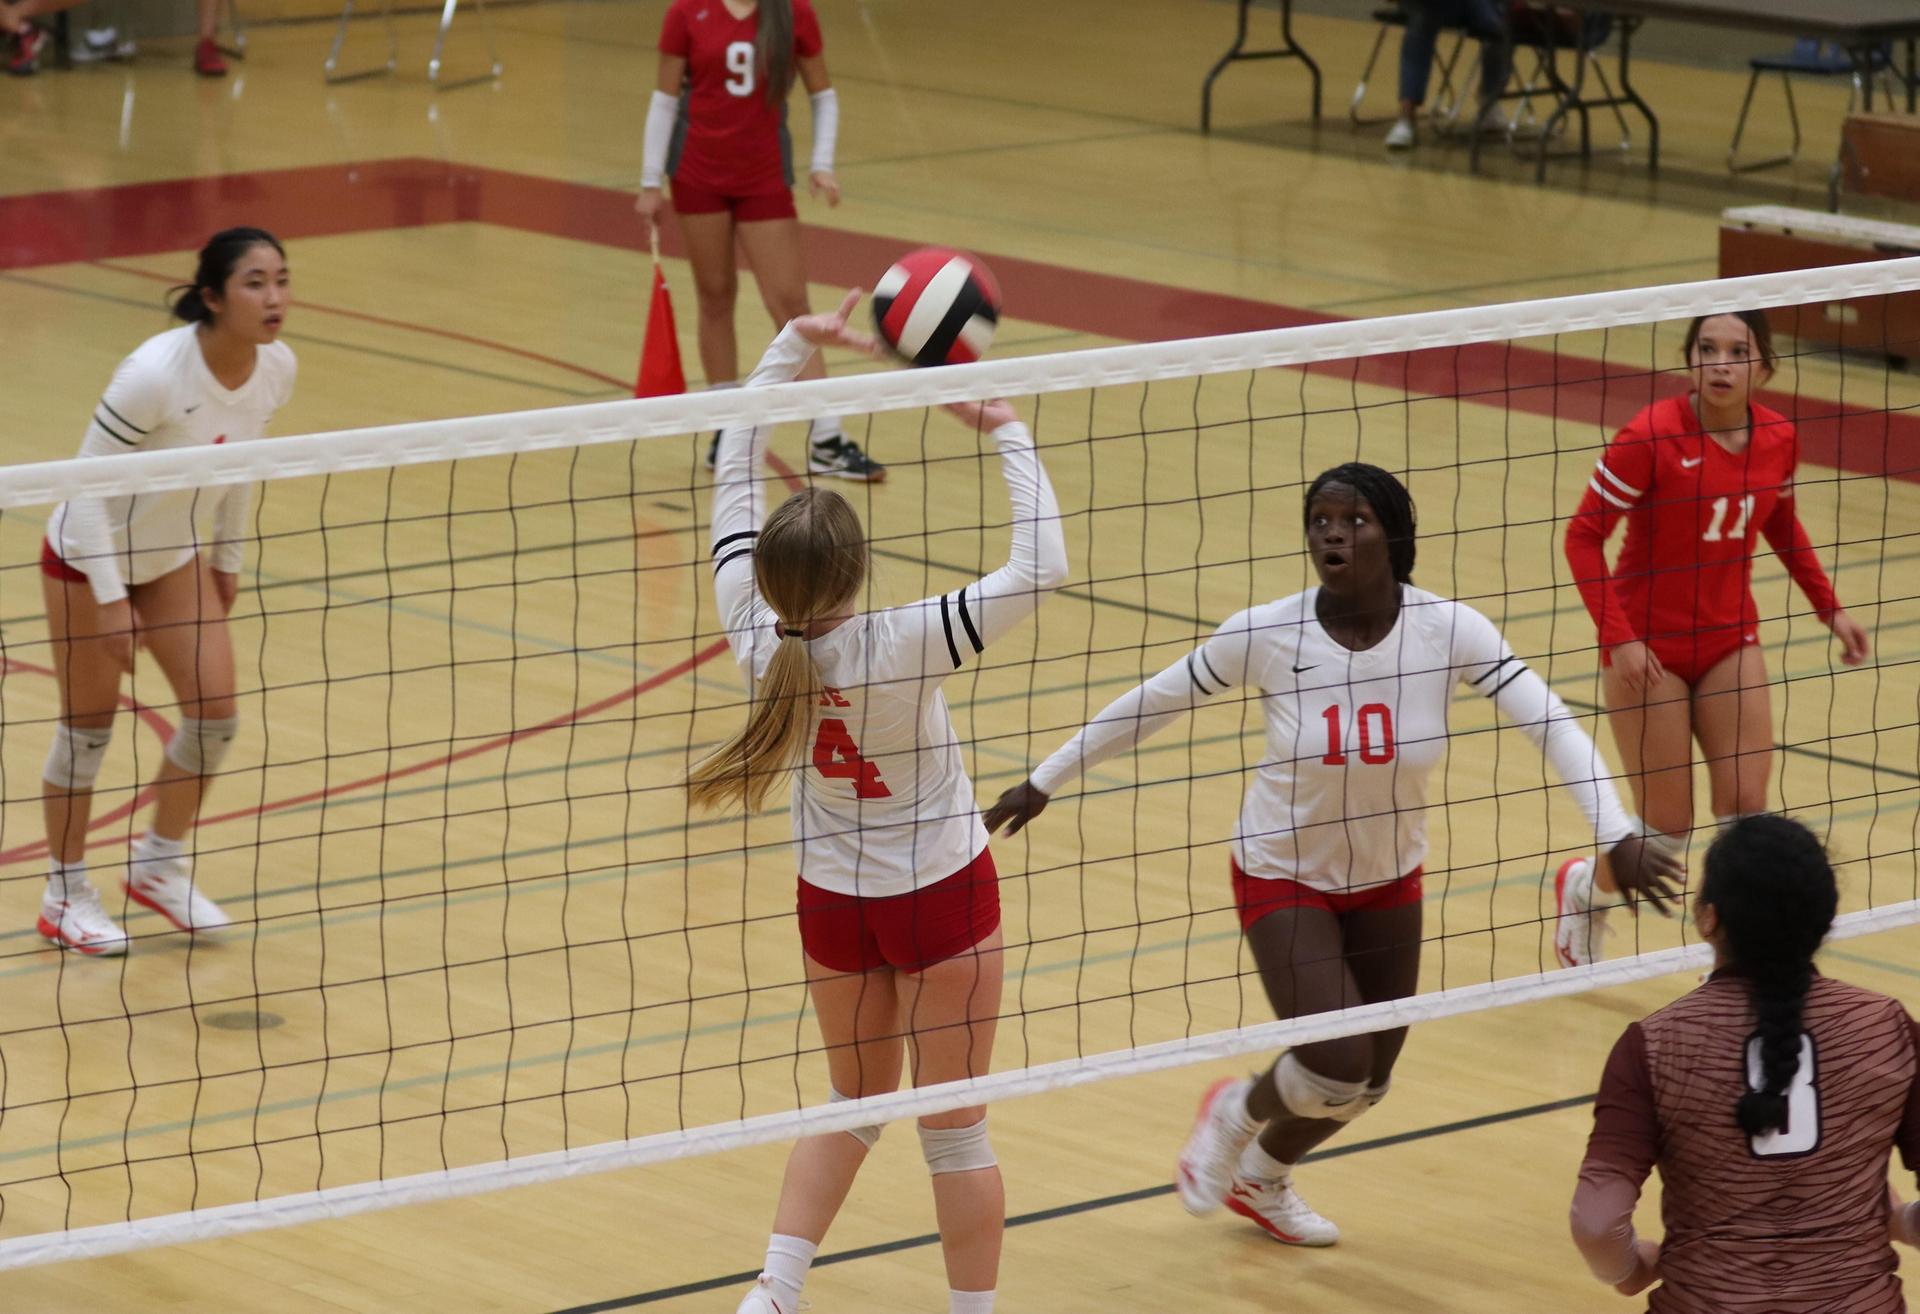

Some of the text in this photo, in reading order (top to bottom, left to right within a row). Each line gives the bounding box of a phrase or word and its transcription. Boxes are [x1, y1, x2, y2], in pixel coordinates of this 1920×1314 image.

[726, 41, 754, 96] 9
[1702, 494, 1755, 541] 11
[812, 718, 893, 799] 4
[1322, 703, 1395, 765] 10
